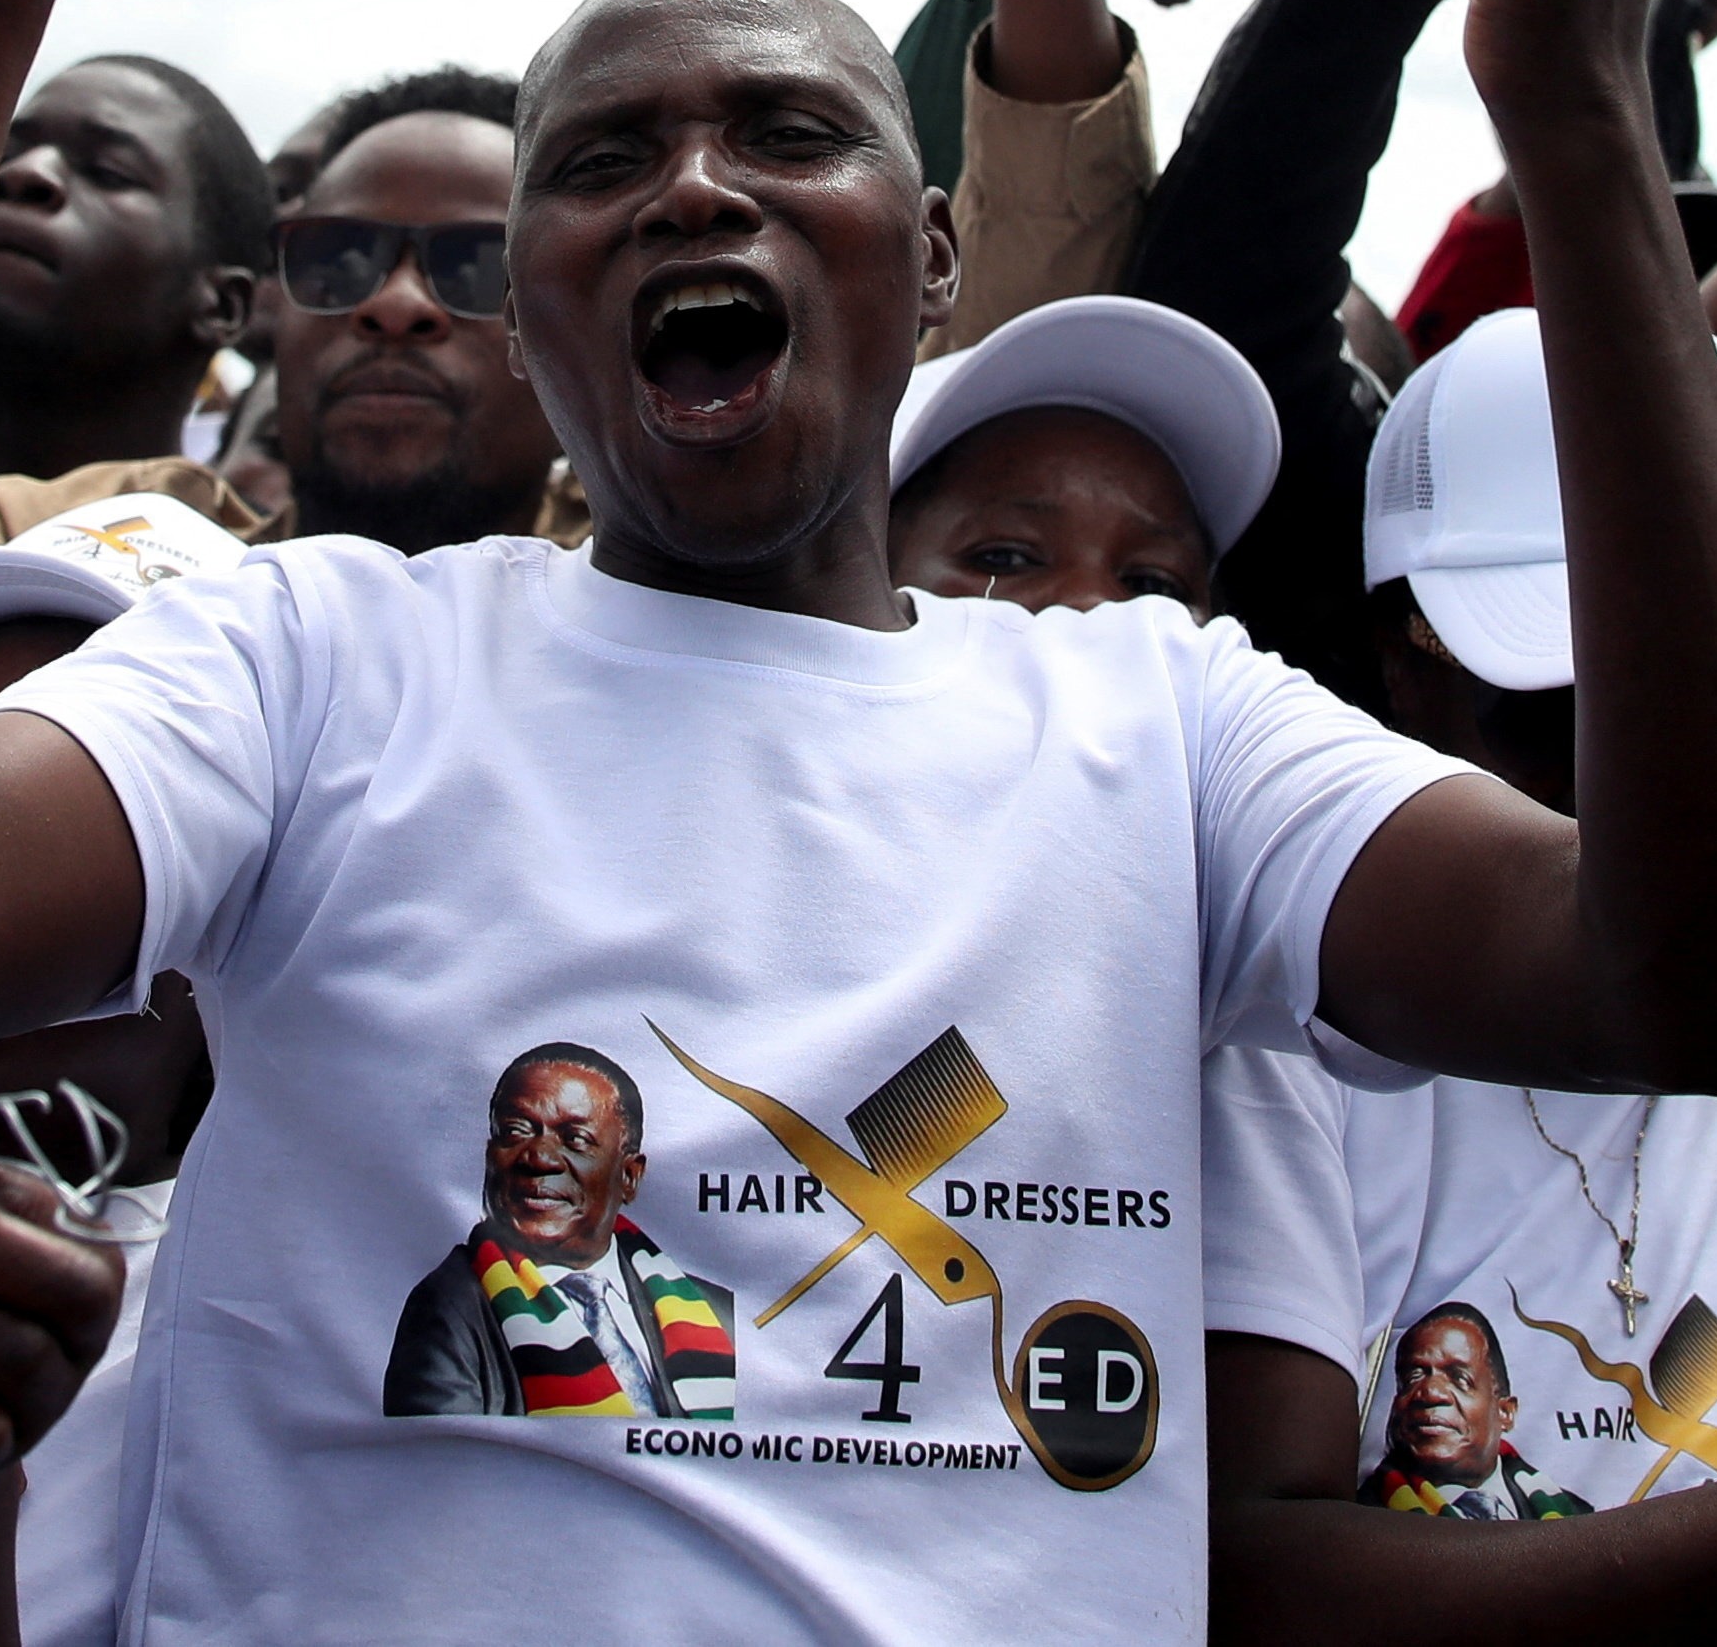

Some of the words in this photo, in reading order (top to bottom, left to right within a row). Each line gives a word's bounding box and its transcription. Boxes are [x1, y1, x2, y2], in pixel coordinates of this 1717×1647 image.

[698, 1172, 824, 1214] HAIR
[945, 1179, 1171, 1228] DRESSERS
[824, 1272, 920, 1424] 4
[1556, 1406, 1635, 1443] HAIR
[813, 1435, 1022, 1471] DEVELOPMENT
